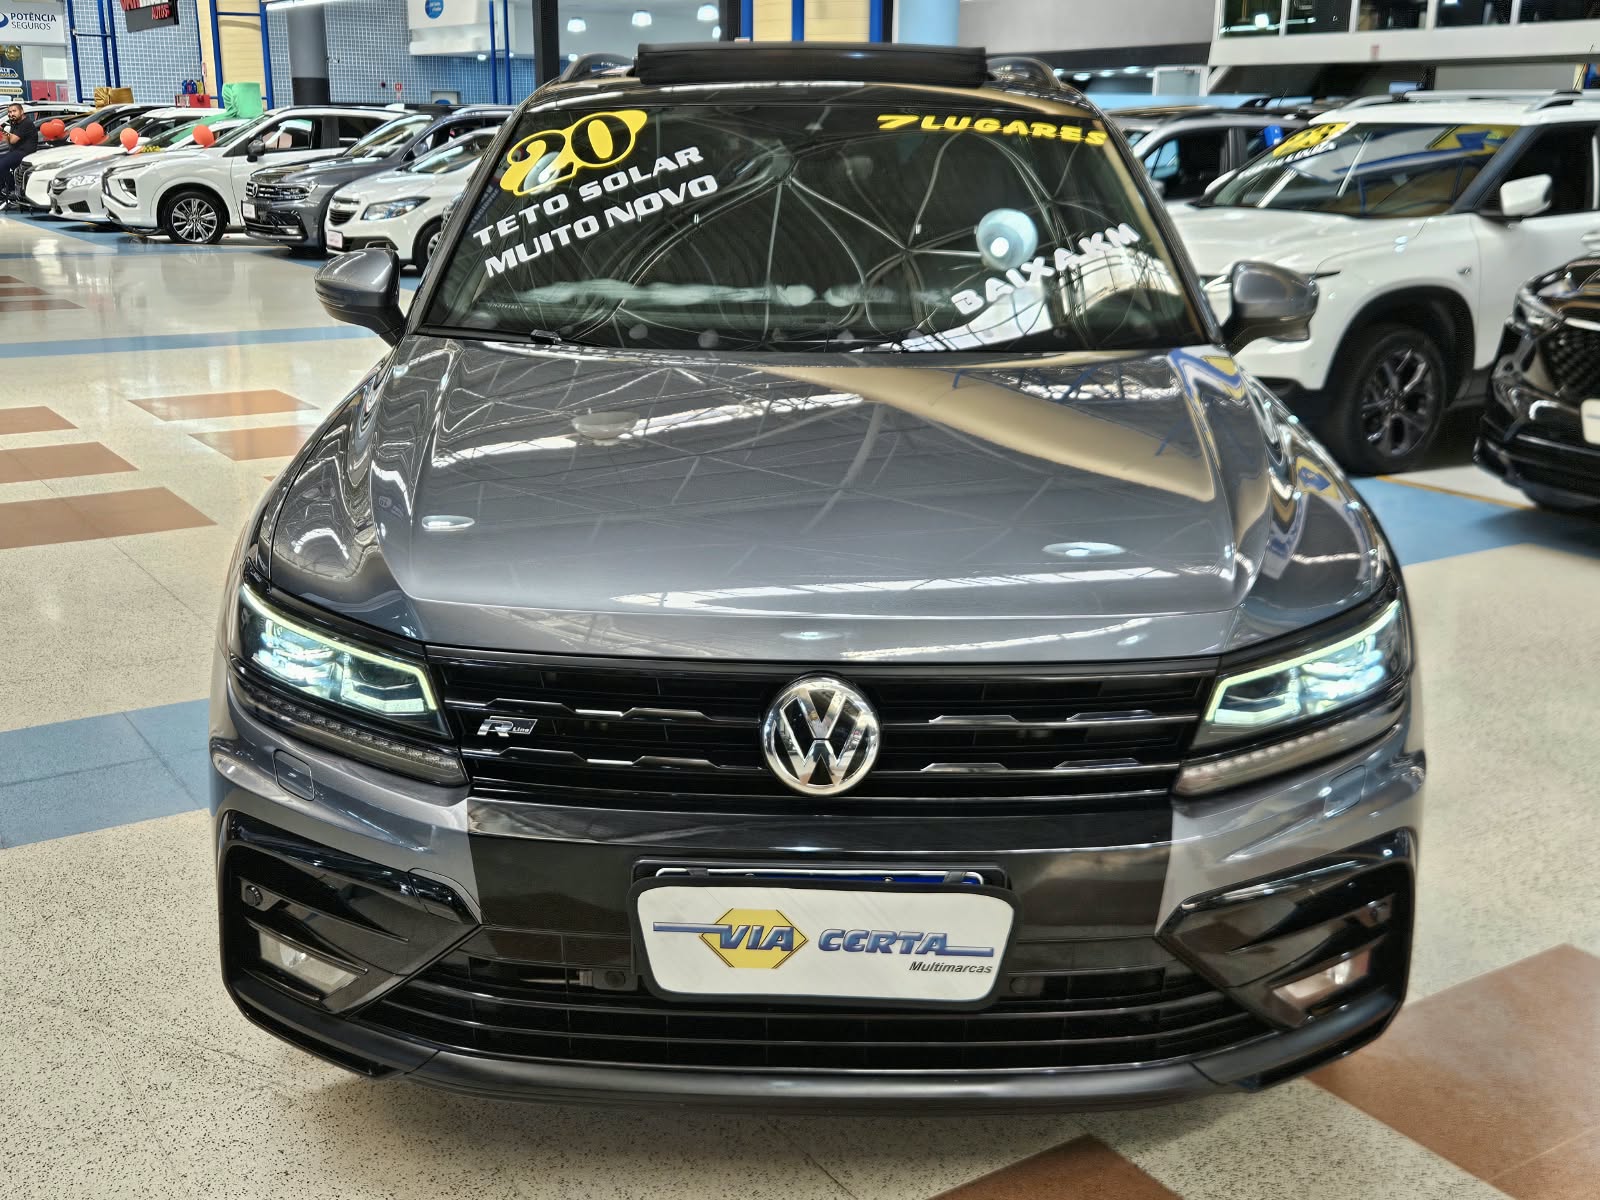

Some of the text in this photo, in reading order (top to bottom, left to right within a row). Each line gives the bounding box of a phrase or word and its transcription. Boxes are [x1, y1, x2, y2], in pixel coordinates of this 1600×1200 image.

[11, 12, 57, 22] POTÊNCIA
[12, 22, 51, 30] SEGUROS
[877, 114, 1107, 145] 7 LUGARES
[473, 193, 569, 246] TETO
[578, 146, 704, 202] SOLAR
[485, 173, 719, 278] MUITO NOVO
[719, 924, 949, 956] VIA CERTA
[909, 960, 993, 975] Multimarcas
